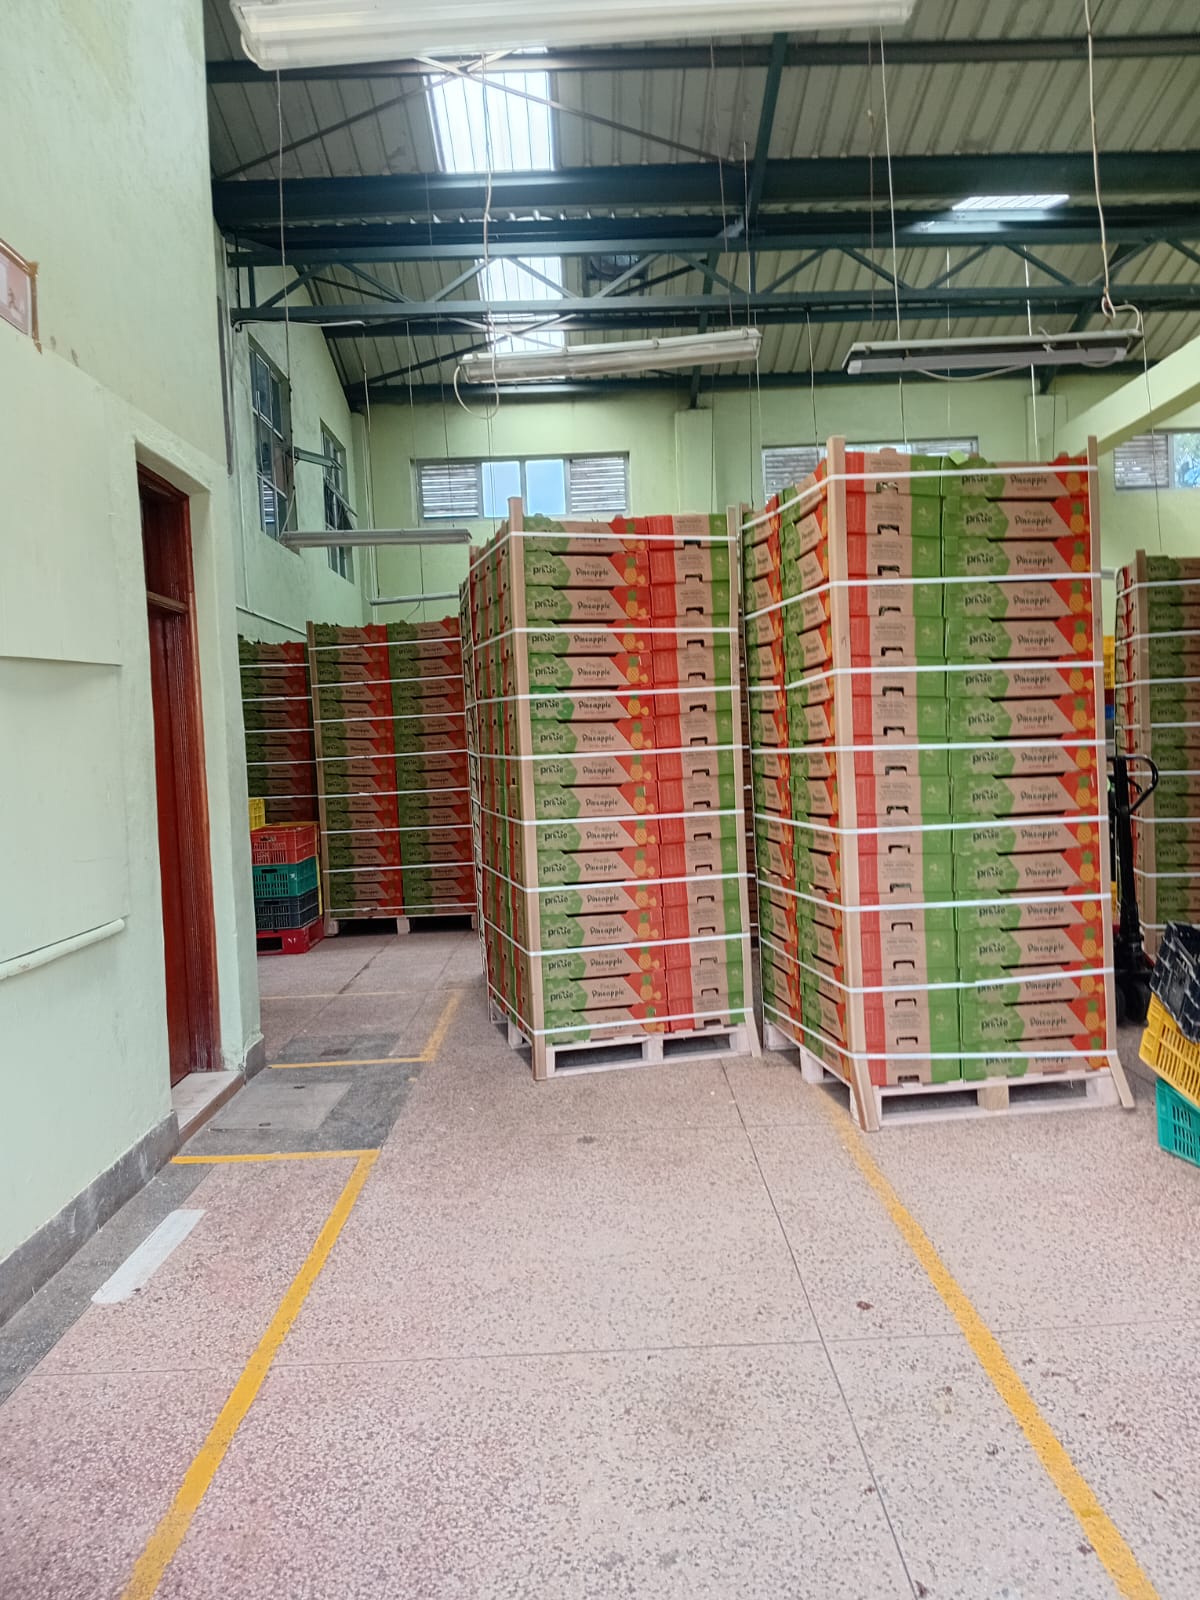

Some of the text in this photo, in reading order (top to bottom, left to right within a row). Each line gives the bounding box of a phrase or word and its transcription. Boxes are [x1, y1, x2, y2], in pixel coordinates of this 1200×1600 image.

[1010, 473, 1047, 486] Pineapple
[1015, 514, 1052, 527] Pineapple
[1016, 555, 1053, 567] Pineapple
[576, 568, 609, 578] Pineapple
[1013, 594, 1050, 606] Pineapple
[577, 601, 610, 611] Pineapple
[574, 635, 607, 645] Pineapple
[1018, 634, 1055, 646] Pineapple
[577, 667, 610, 677] Pineapple
[1014, 673, 1050, 685] Pineapple
[578, 701, 611, 710] Pineapple
[1016, 713, 1054, 724] Pineapple
[582, 733, 614, 743] Pineapple
[1021, 752, 1058, 763] Pineapple
[583, 765, 615, 775] Pineapple
[1021, 791, 1058, 802] Pineapple
[585, 798, 617, 808] Pineapple
[586, 830, 618, 841] Pineapple
[1021, 829, 1059, 840] Pineapple
[585, 862, 617, 873] Pineapple
[1025, 866, 1062, 878] Pineapple
[587, 894, 619, 904] Pineapple
[1027, 905, 1065, 916] Pineapple
[590, 926, 622, 936] Pineapple
[1027, 942, 1064, 953] Pineapple
[590, 958, 622, 968] Pineapple
[1025, 979, 1062, 990] Pineapple
[592, 988, 624, 999] Pineapple
[1030, 1015, 1067, 1027] Pineapple
